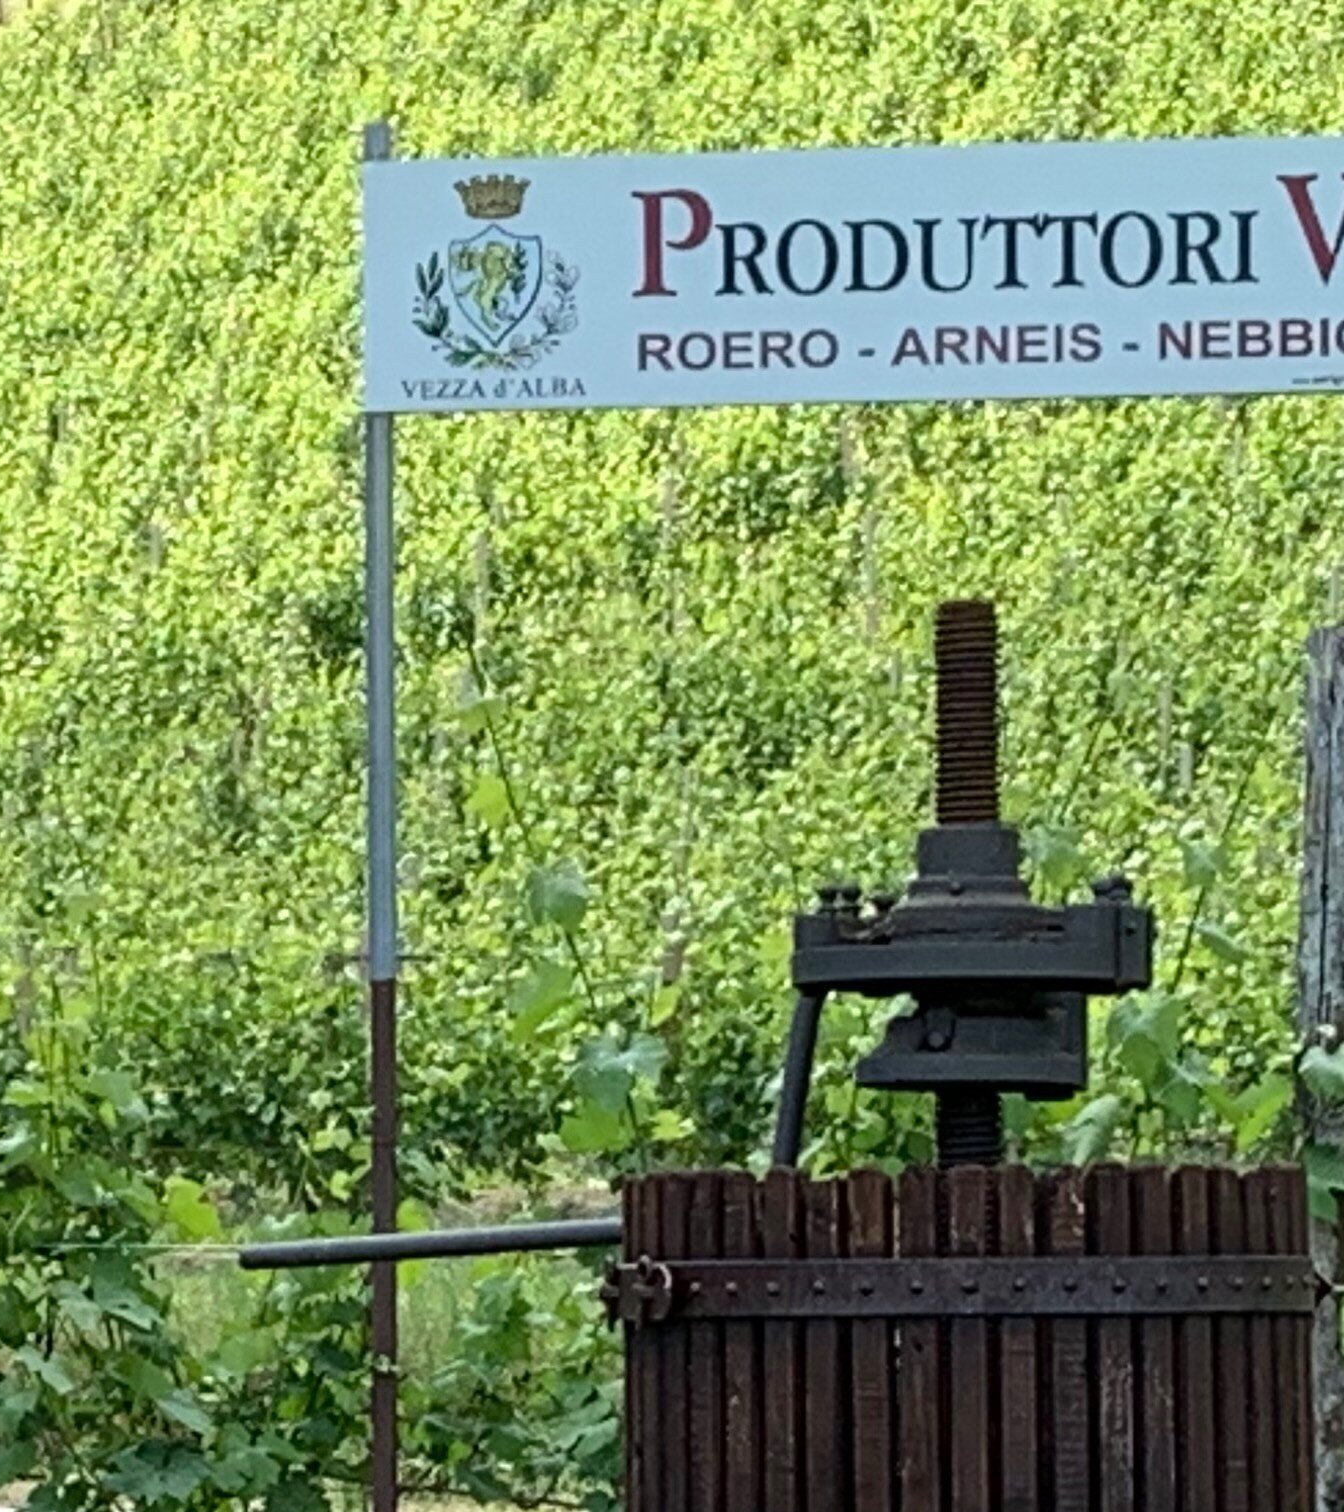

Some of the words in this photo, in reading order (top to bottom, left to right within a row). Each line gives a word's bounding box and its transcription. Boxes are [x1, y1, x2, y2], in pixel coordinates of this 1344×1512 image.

[631, 187, 1259, 298] PRODUTTORI
[637, 328, 840, 372] ROERO
[890, 321, 1103, 367] ARNEIS
[401, 378, 485, 400] VEZZA
